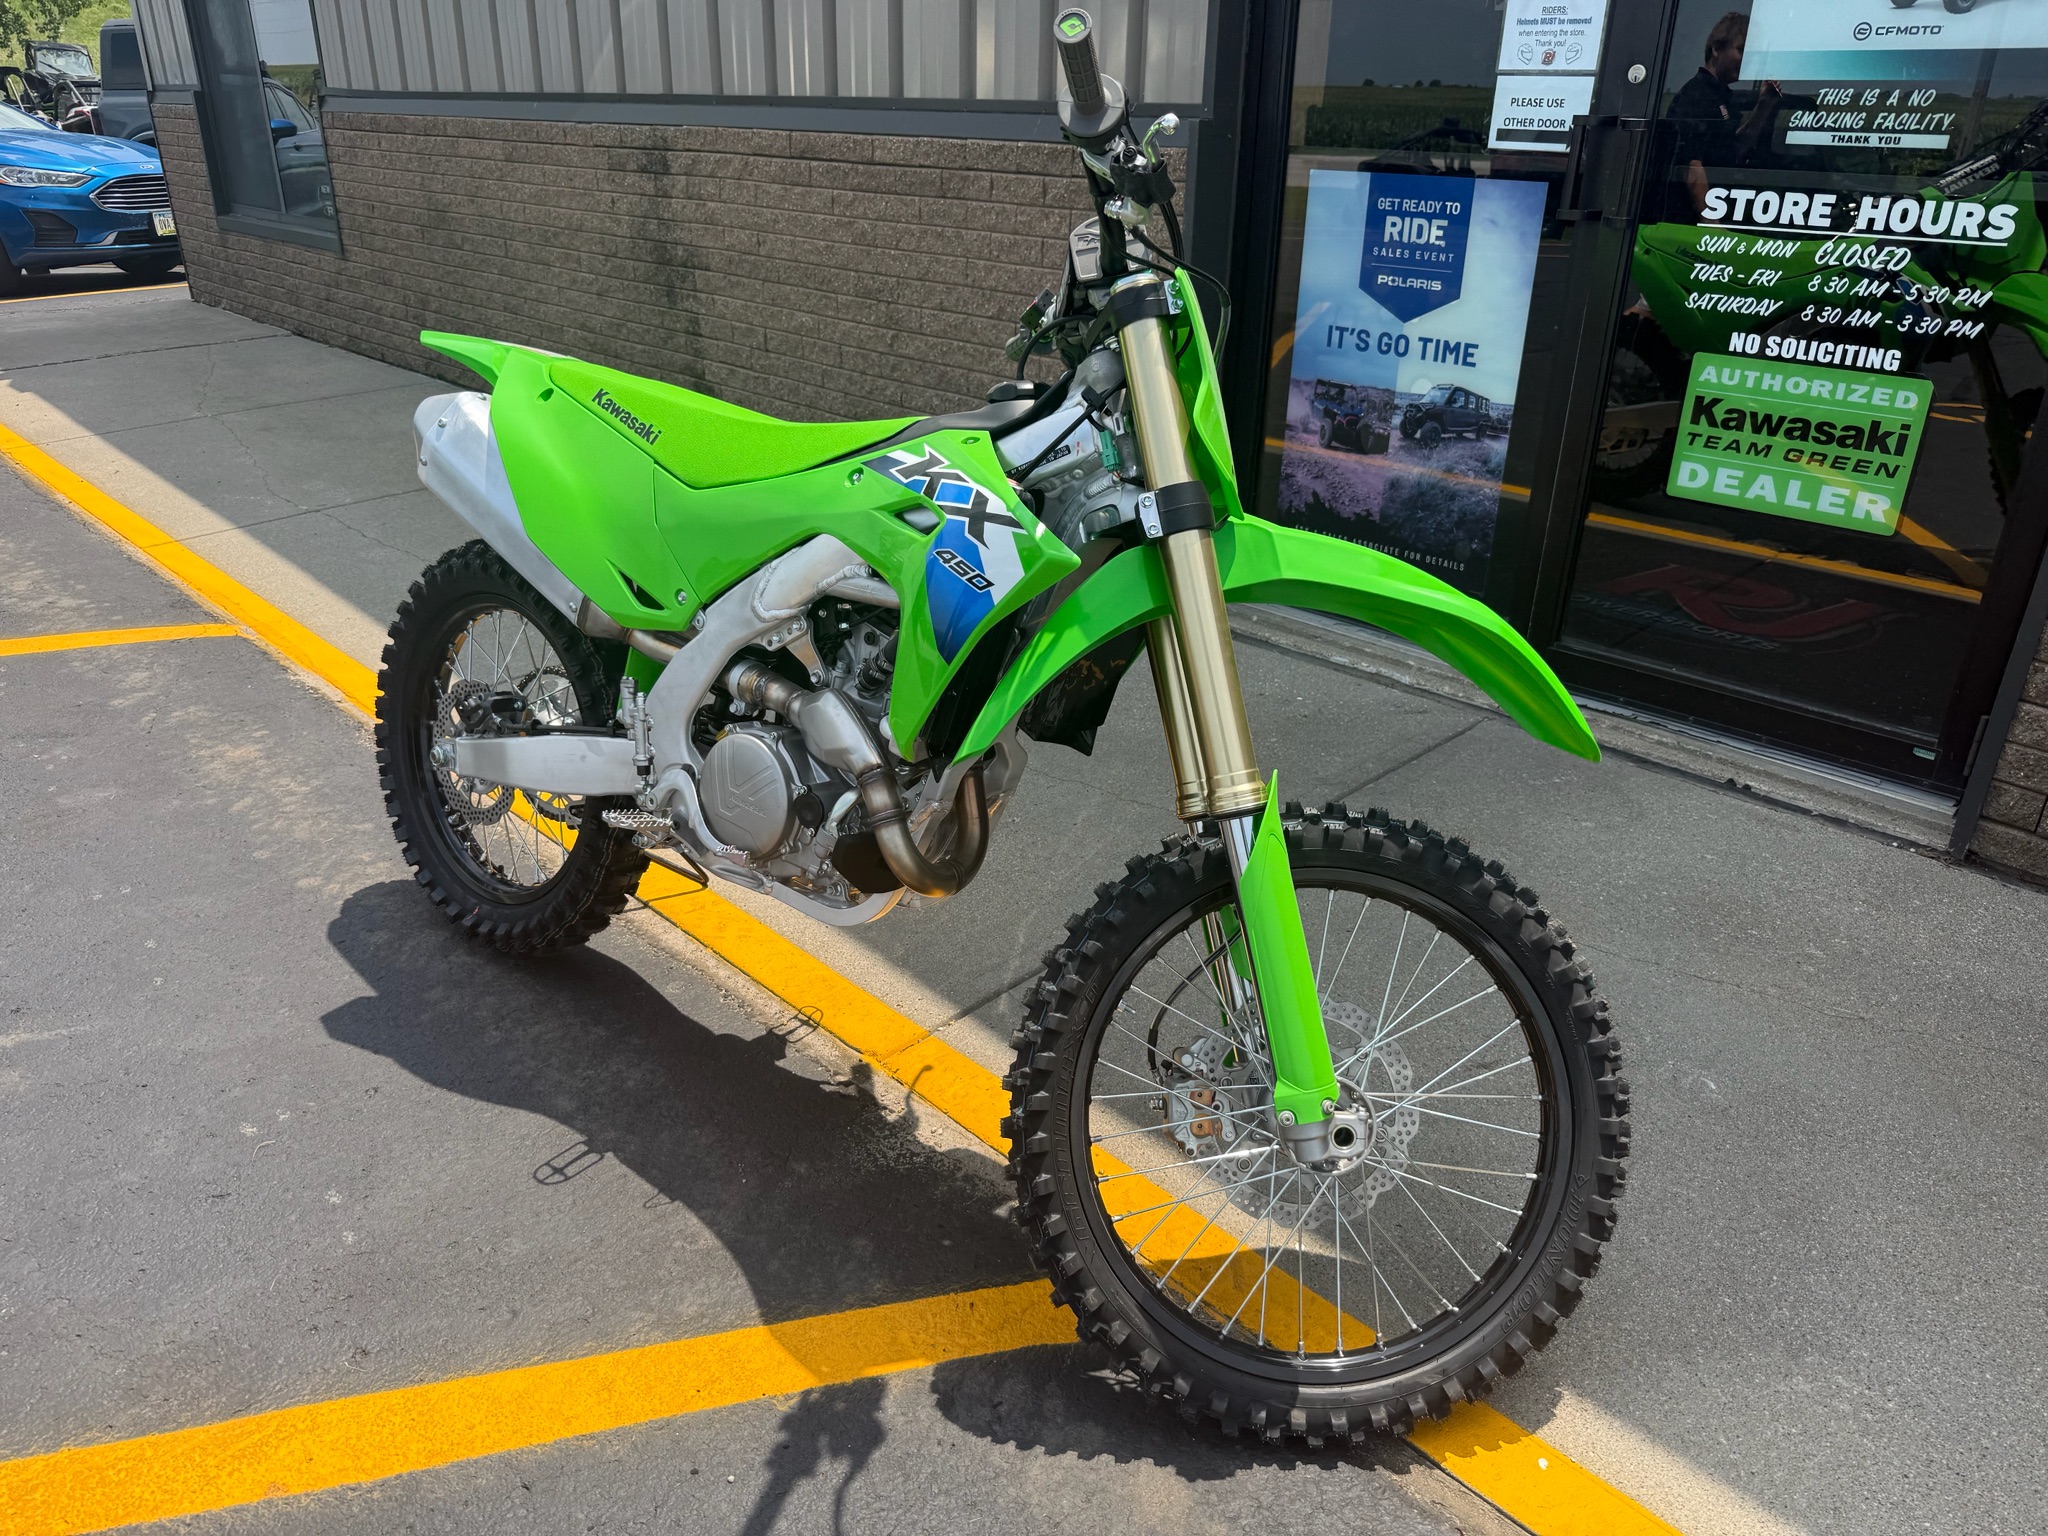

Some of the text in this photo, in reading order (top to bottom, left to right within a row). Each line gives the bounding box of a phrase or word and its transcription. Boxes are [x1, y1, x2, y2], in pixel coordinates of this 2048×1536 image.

[1516, 16, 1593, 26] Helmets MUST be removed
[1541, 6, 1569, 15] RIDERS:
[1534, 29, 1558, 38] entering
[1535, 39, 1567, 48] Thank you!
[1875, 25, 1942, 36] CFMOTO
[1510, 97, 1566, 108] PLEASE USE
[1816, 88, 1936, 107] THIS IS A NO
[1503, 117, 1566, 129] OTHER DOOR
[1788, 111, 1955, 131] SMOKING FACILITY
[1831, 134, 1902, 145] THANK YOU
[1377, 197, 1461, 215] GET READY TO
[1700, 187, 2020, 240] STORE HOURS
[1383, 215, 1448, 247] RIDE
[1372, 246, 1454, 263] SALES EVENT
[1696, 234, 1912, 271] SUN & MON CLOSED
[1377, 274, 1442, 291] POLARIS
[1690, 263, 1734, 282] TUES
[1747, 269, 1783, 287] FRI
[1807, 274, 1822, 292] 8
[1824, 276, 1849, 294] 30
[1850, 278, 1890, 298] AM
[1905, 284, 1922, 301] 5
[1923, 285, 1950, 304] 30
[1952, 288, 1994, 308] PM
[1684, 292, 1784, 316] SATURDAY
[1800, 304, 1815, 322] 8
[1816, 306, 1842, 324] 30
[1842, 308, 1883, 329] AM
[1896, 314, 1914, 332] 3
[1914, 316, 1942, 335] 30
[1943, 318, 1985, 340] PM
[1326, 324, 1479, 368] IT'S GO TIME
[1728, 331, 1902, 372] NO SOLICITING
[1698, 365, 1919, 409] AUTHORIZED
[591, 387, 662, 446] Kawasaki
[1689, 395, 1912, 457] Kawasaki
[1687, 432, 1900, 479] TEAM GREEN
[891, 446, 1026, 550] KX
[1676, 461, 1892, 523] DEALER
[934, 550, 995, 592] 450
[1404, 550, 1421, 561] FOR
[1425, 556, 1465, 572] DETAILS
